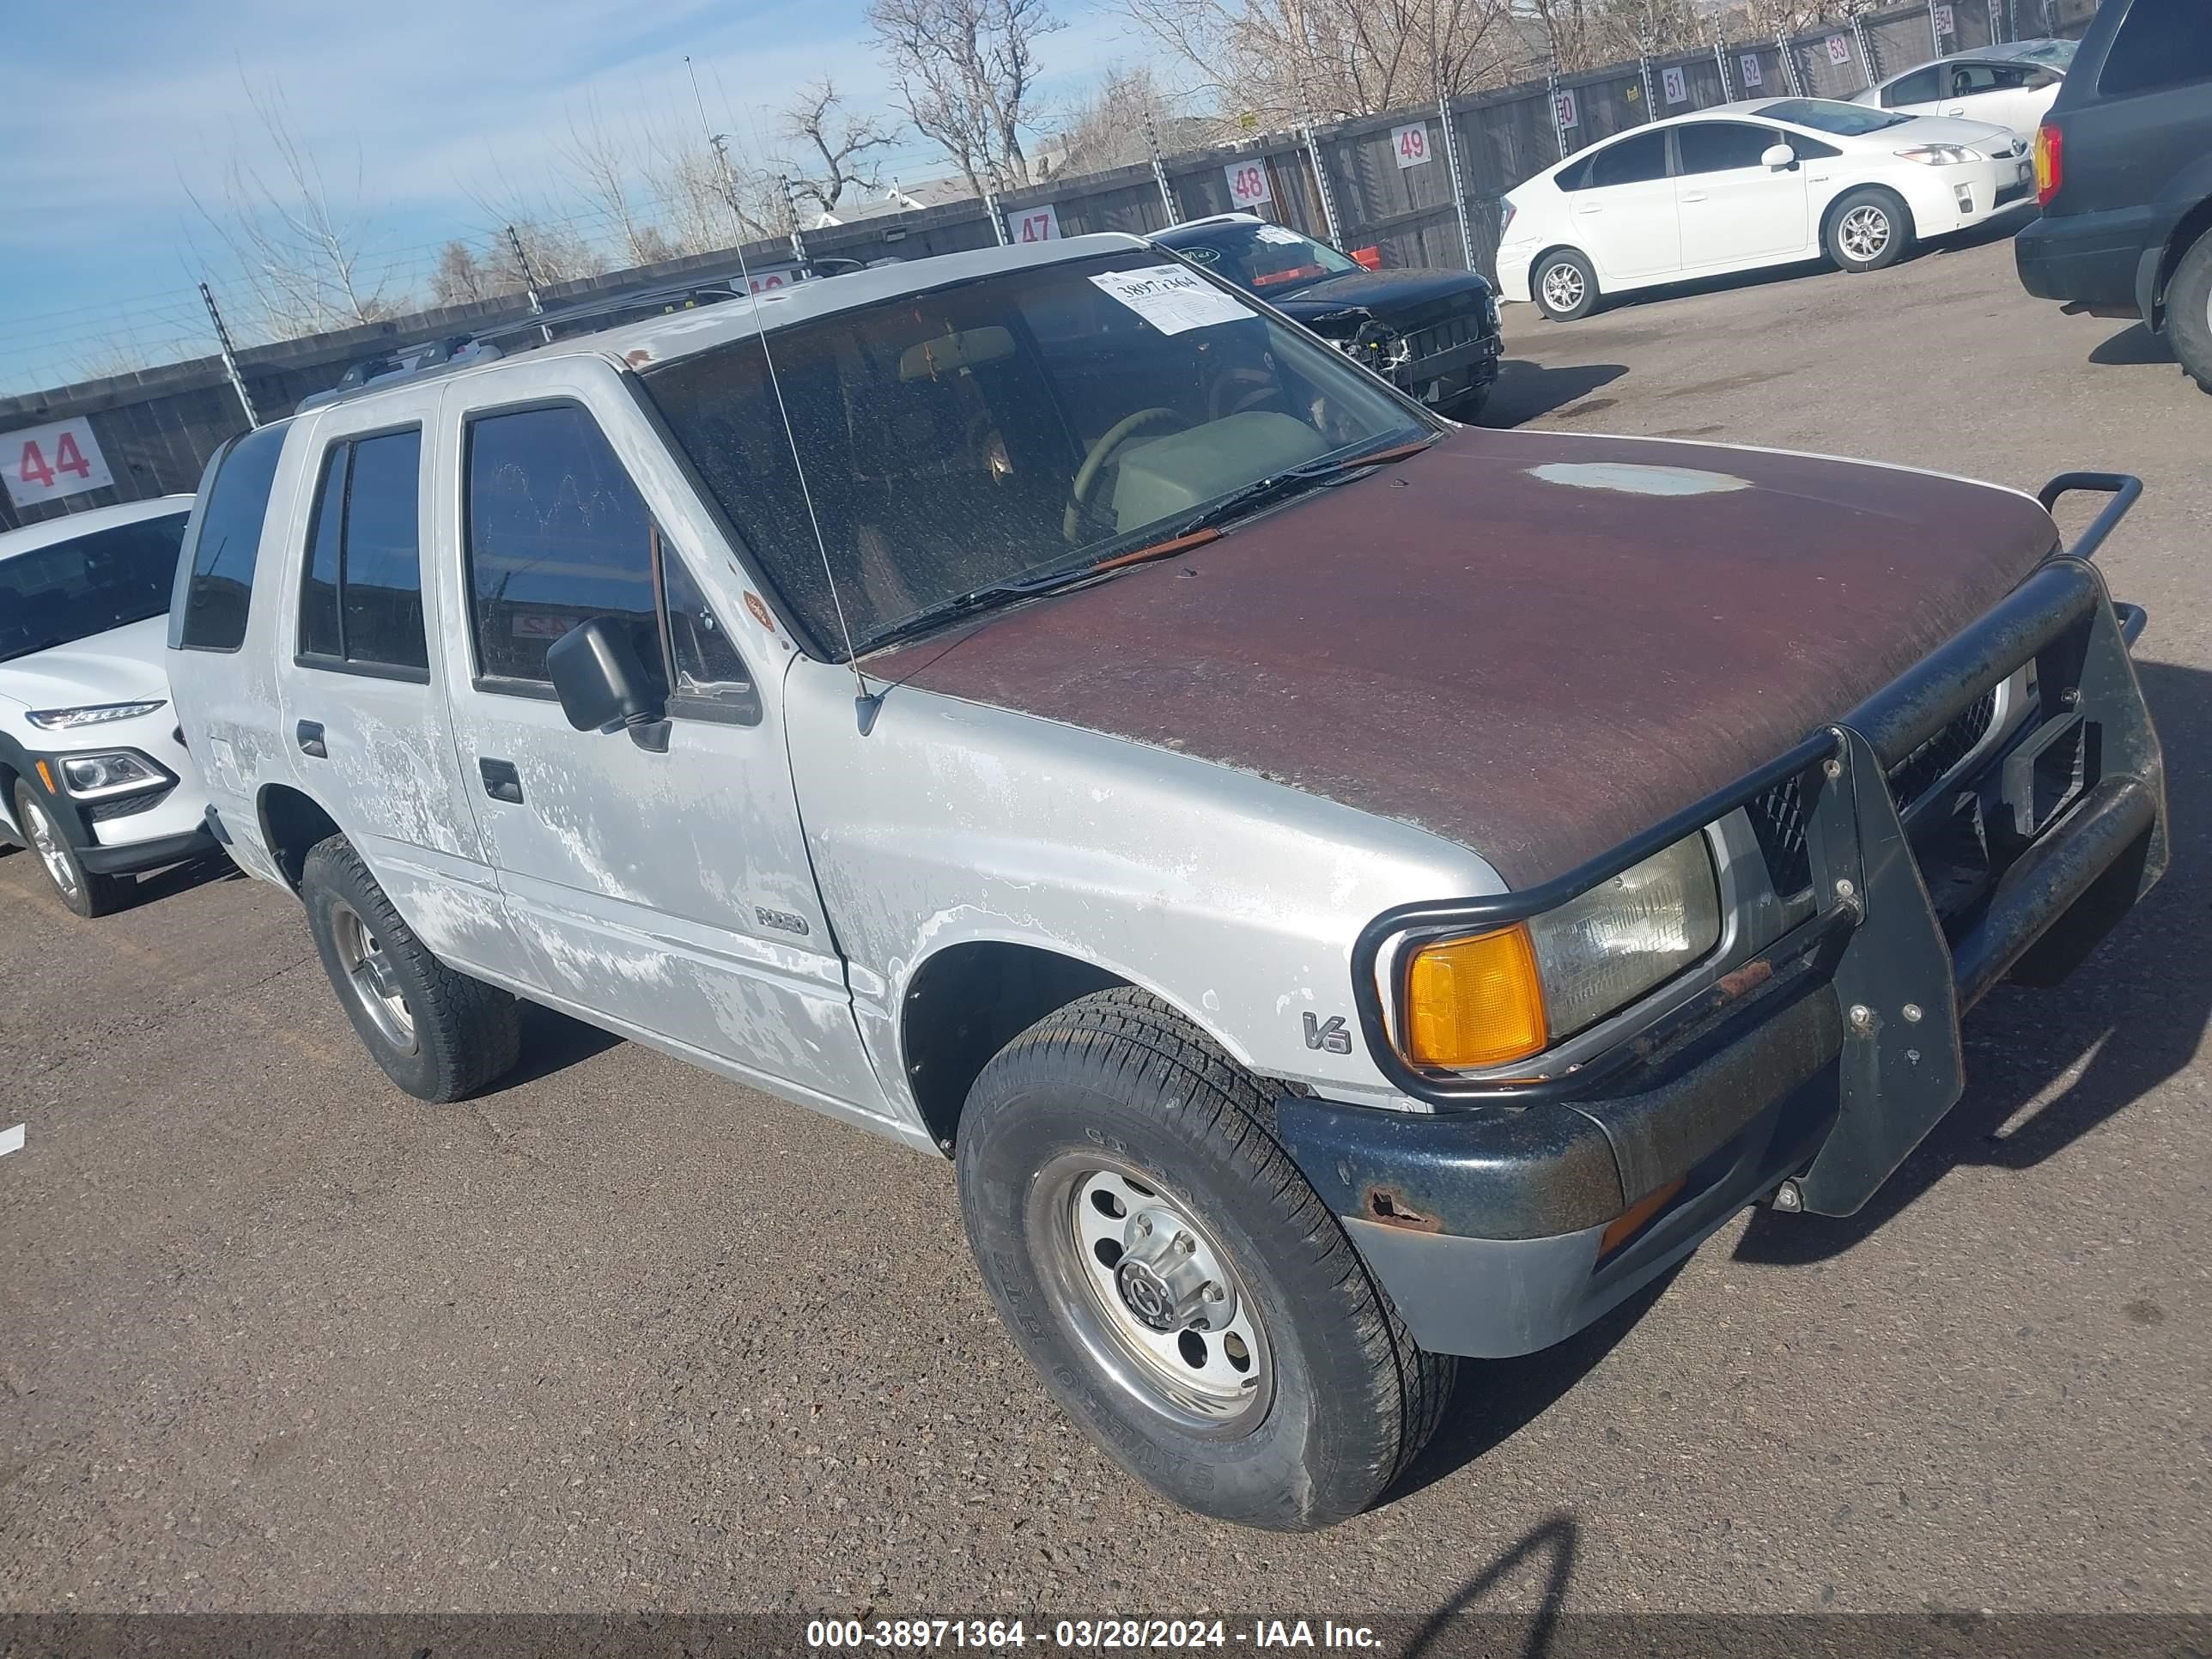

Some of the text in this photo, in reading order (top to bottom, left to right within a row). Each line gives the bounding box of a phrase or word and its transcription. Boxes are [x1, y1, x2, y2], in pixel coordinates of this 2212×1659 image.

[1830, 38, 1846, 59] 53
[1744, 59, 1759, 82] 52
[1667, 72, 1683, 99] 51
[1400, 130, 1424, 159] 49
[1237, 167, 1263, 198] 48
[1023, 214, 1049, 243] 47
[19, 432, 91, 487] 44
[1303, 1012, 1352, 1054] V6
